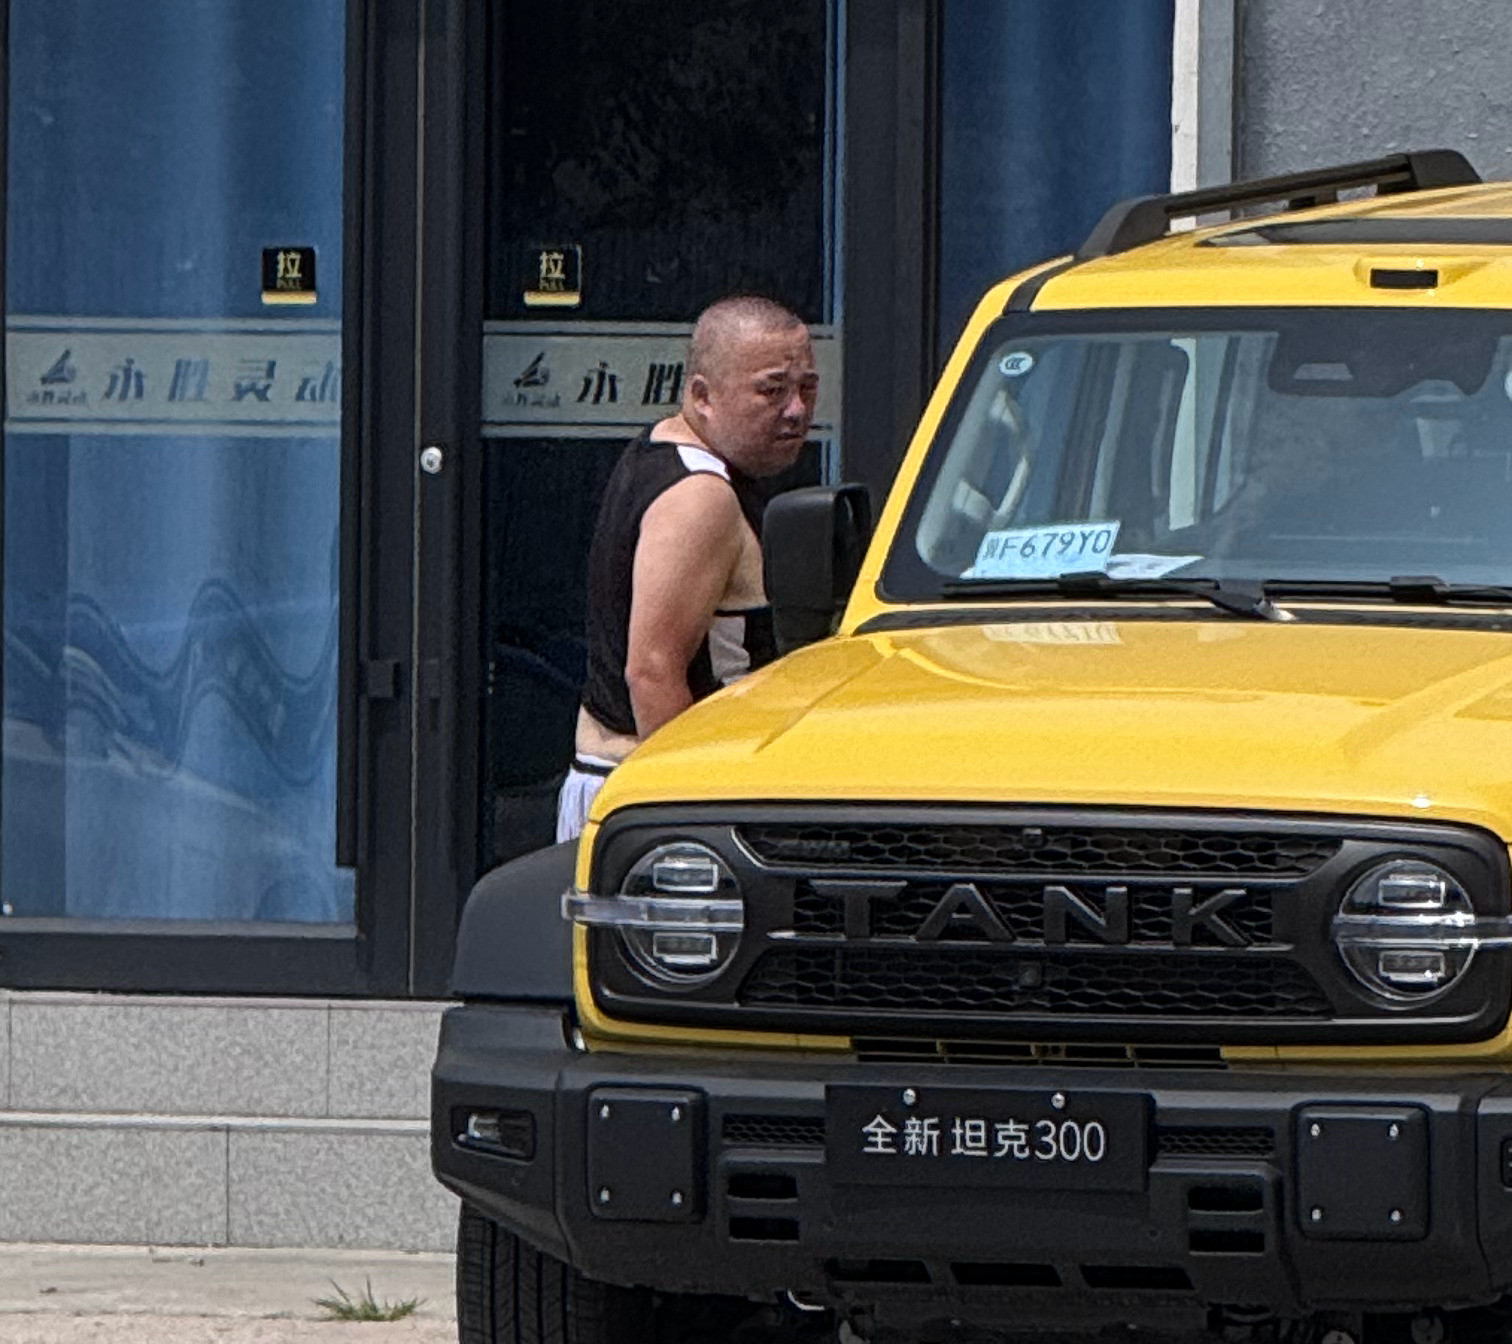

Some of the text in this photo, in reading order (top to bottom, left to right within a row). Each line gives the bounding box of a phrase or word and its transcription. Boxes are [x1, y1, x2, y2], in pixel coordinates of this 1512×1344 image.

[277, 251, 302, 278] 拉
[540, 251, 565, 279] 拉
[809, 878, 1254, 946] TANK
[861, 1114, 1106, 1162] 全新 坦克300
